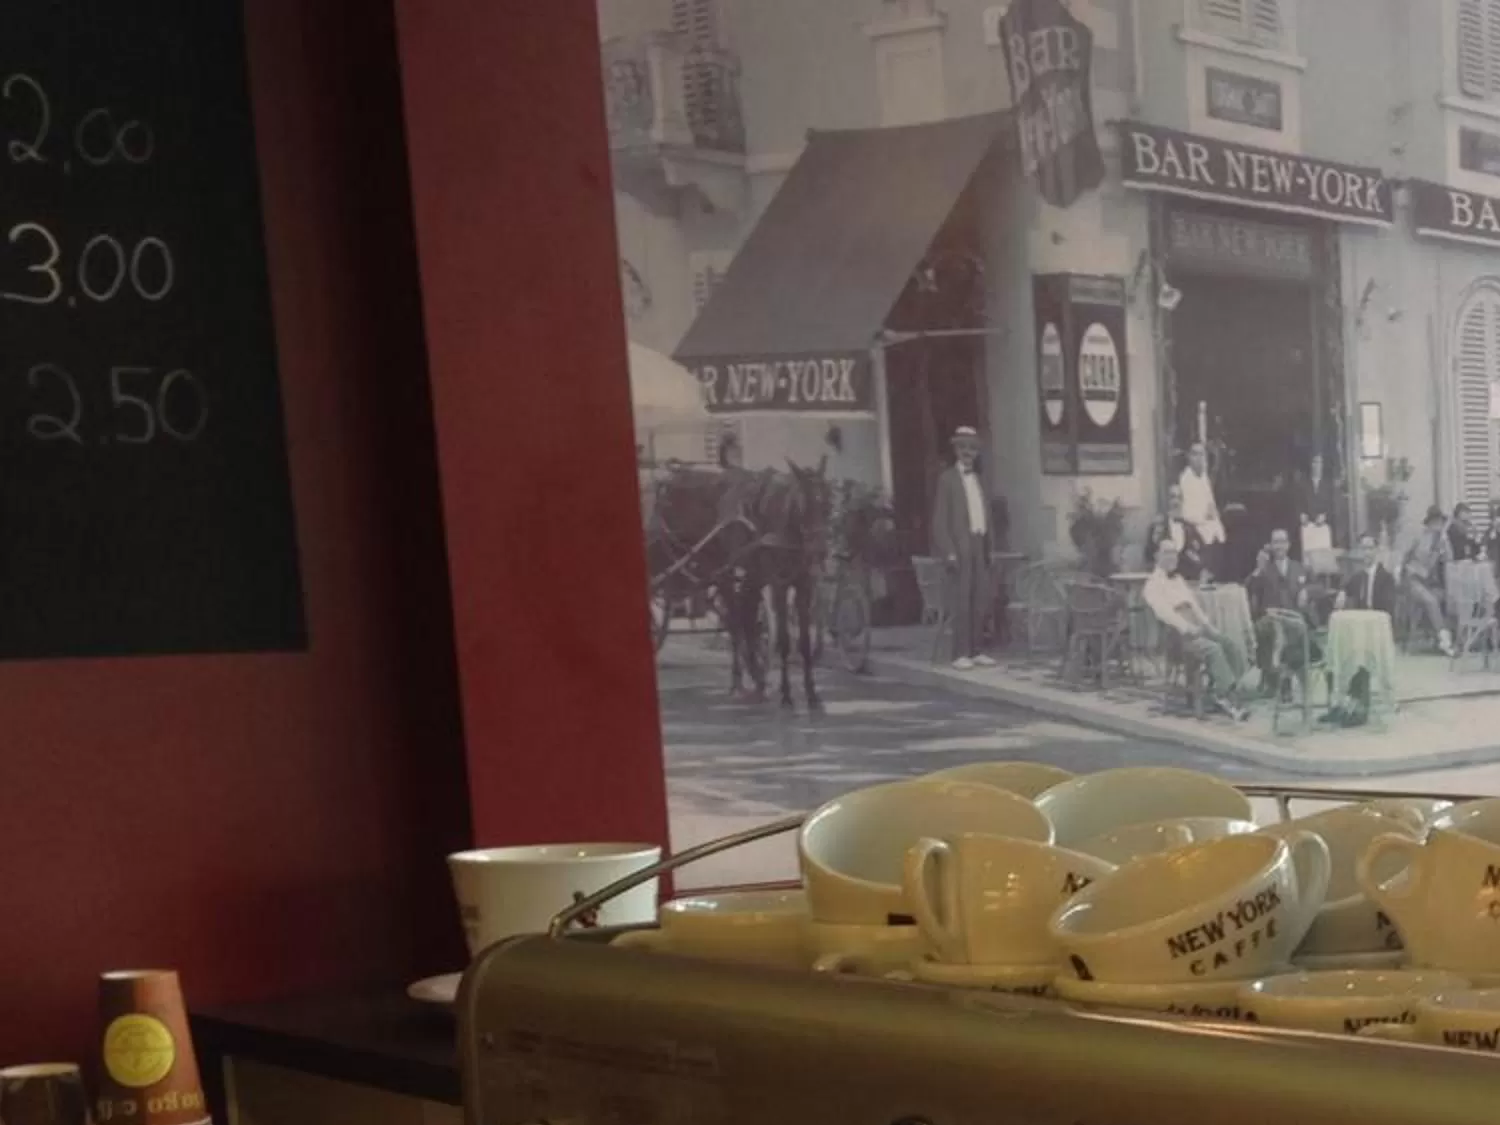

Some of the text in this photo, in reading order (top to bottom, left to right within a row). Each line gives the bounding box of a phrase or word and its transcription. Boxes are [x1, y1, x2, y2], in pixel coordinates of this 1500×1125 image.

[1132, 132, 1214, 185] BAR
[1224, 148, 1385, 213] NEW-YORK
[2, 222, 175, 308] 3.00
[722, 358, 856, 404] NEW-YORK
[1166, 880, 1281, 959] NEW YORK
